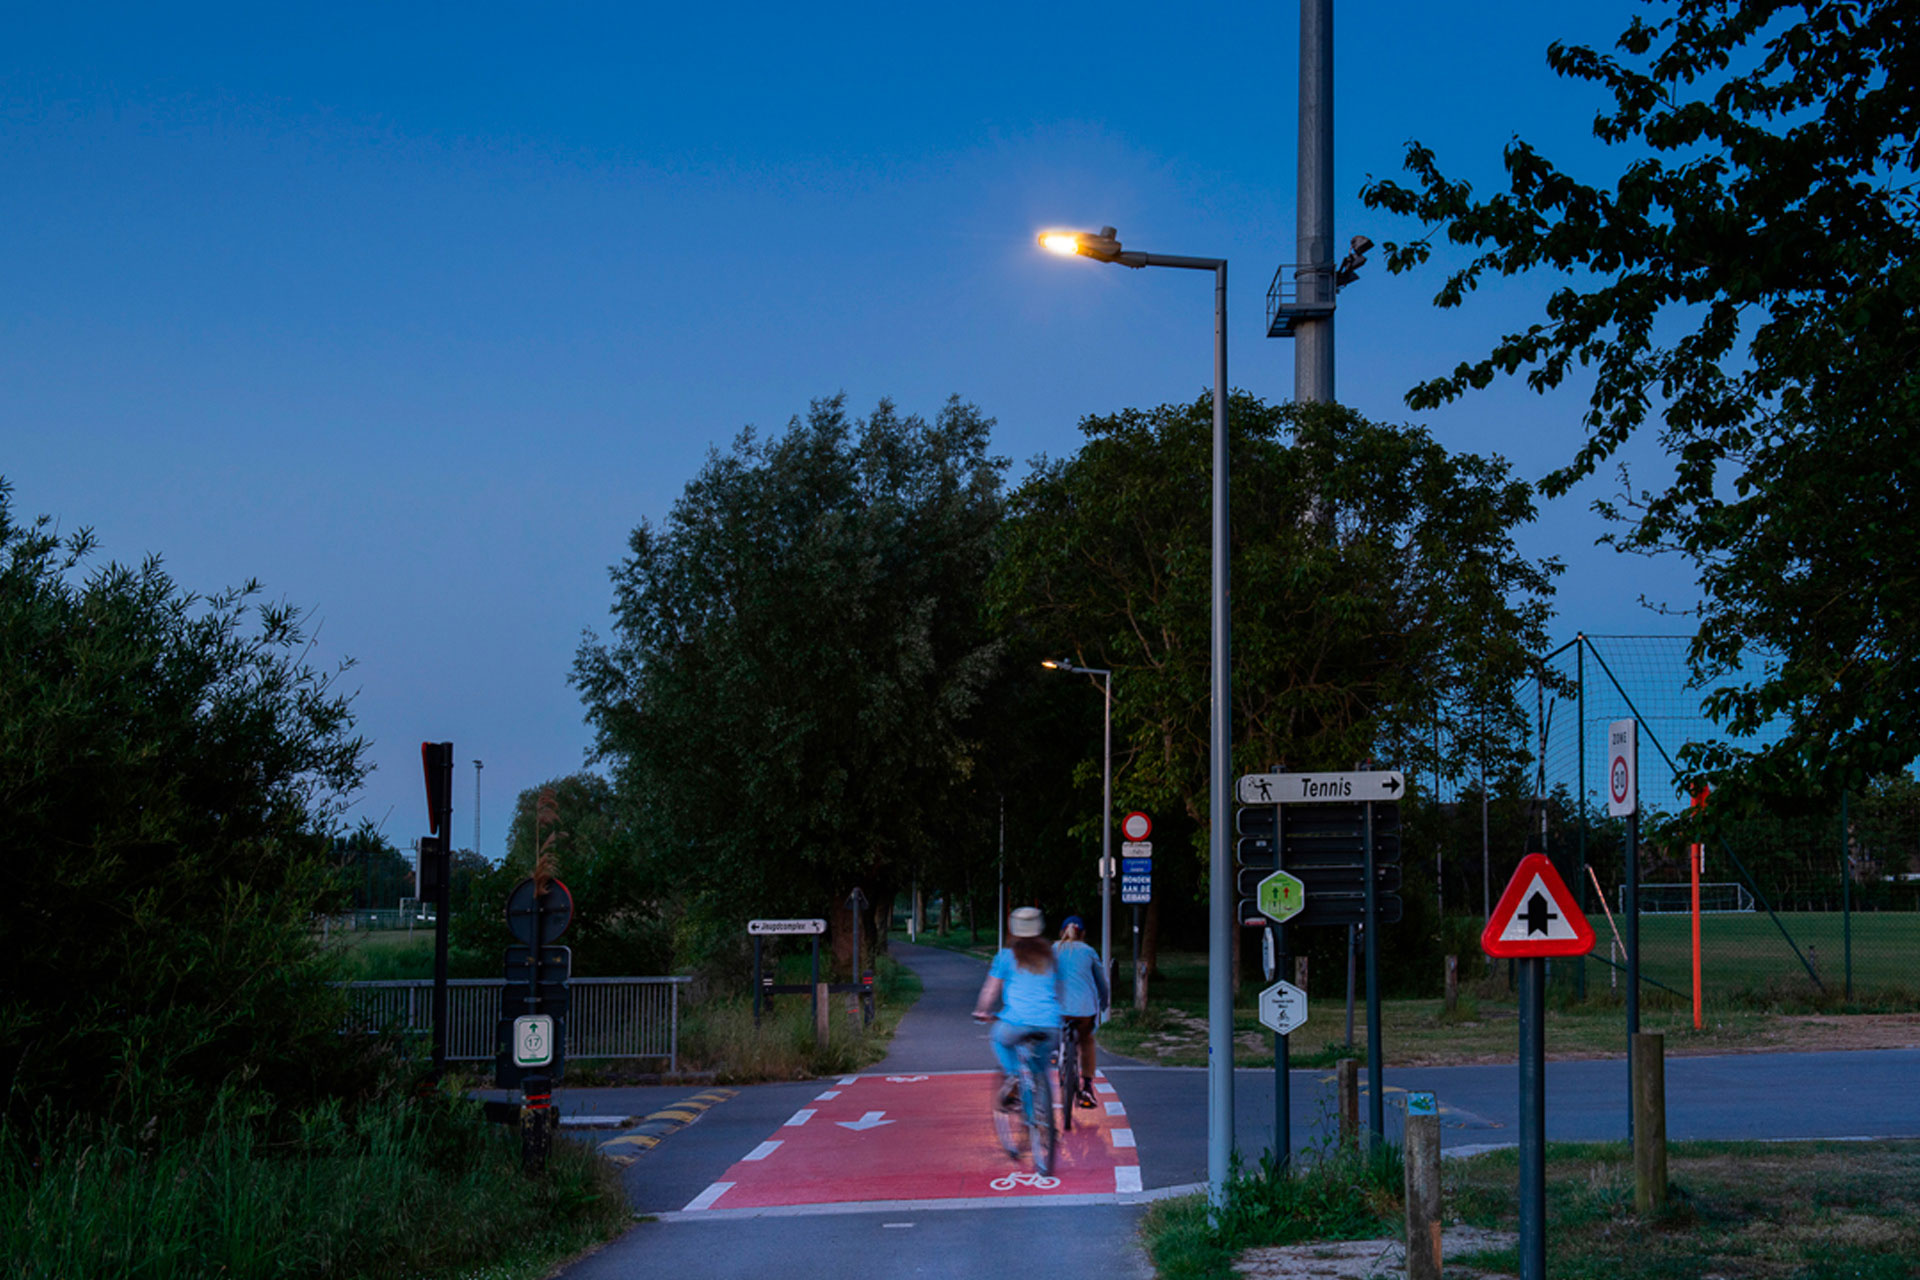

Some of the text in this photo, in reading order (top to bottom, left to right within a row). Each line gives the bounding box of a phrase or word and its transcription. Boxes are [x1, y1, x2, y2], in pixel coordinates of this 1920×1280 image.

[1613, 731, 1627, 745] ZONE
[1302, 776, 1352, 797] Tennis
[1615, 771, 1626, 790] 30
[1122, 885, 1151, 893] AAN DE
[1122, 894, 1151, 902] LEIBAND
[528, 1037, 541, 1047] 17
